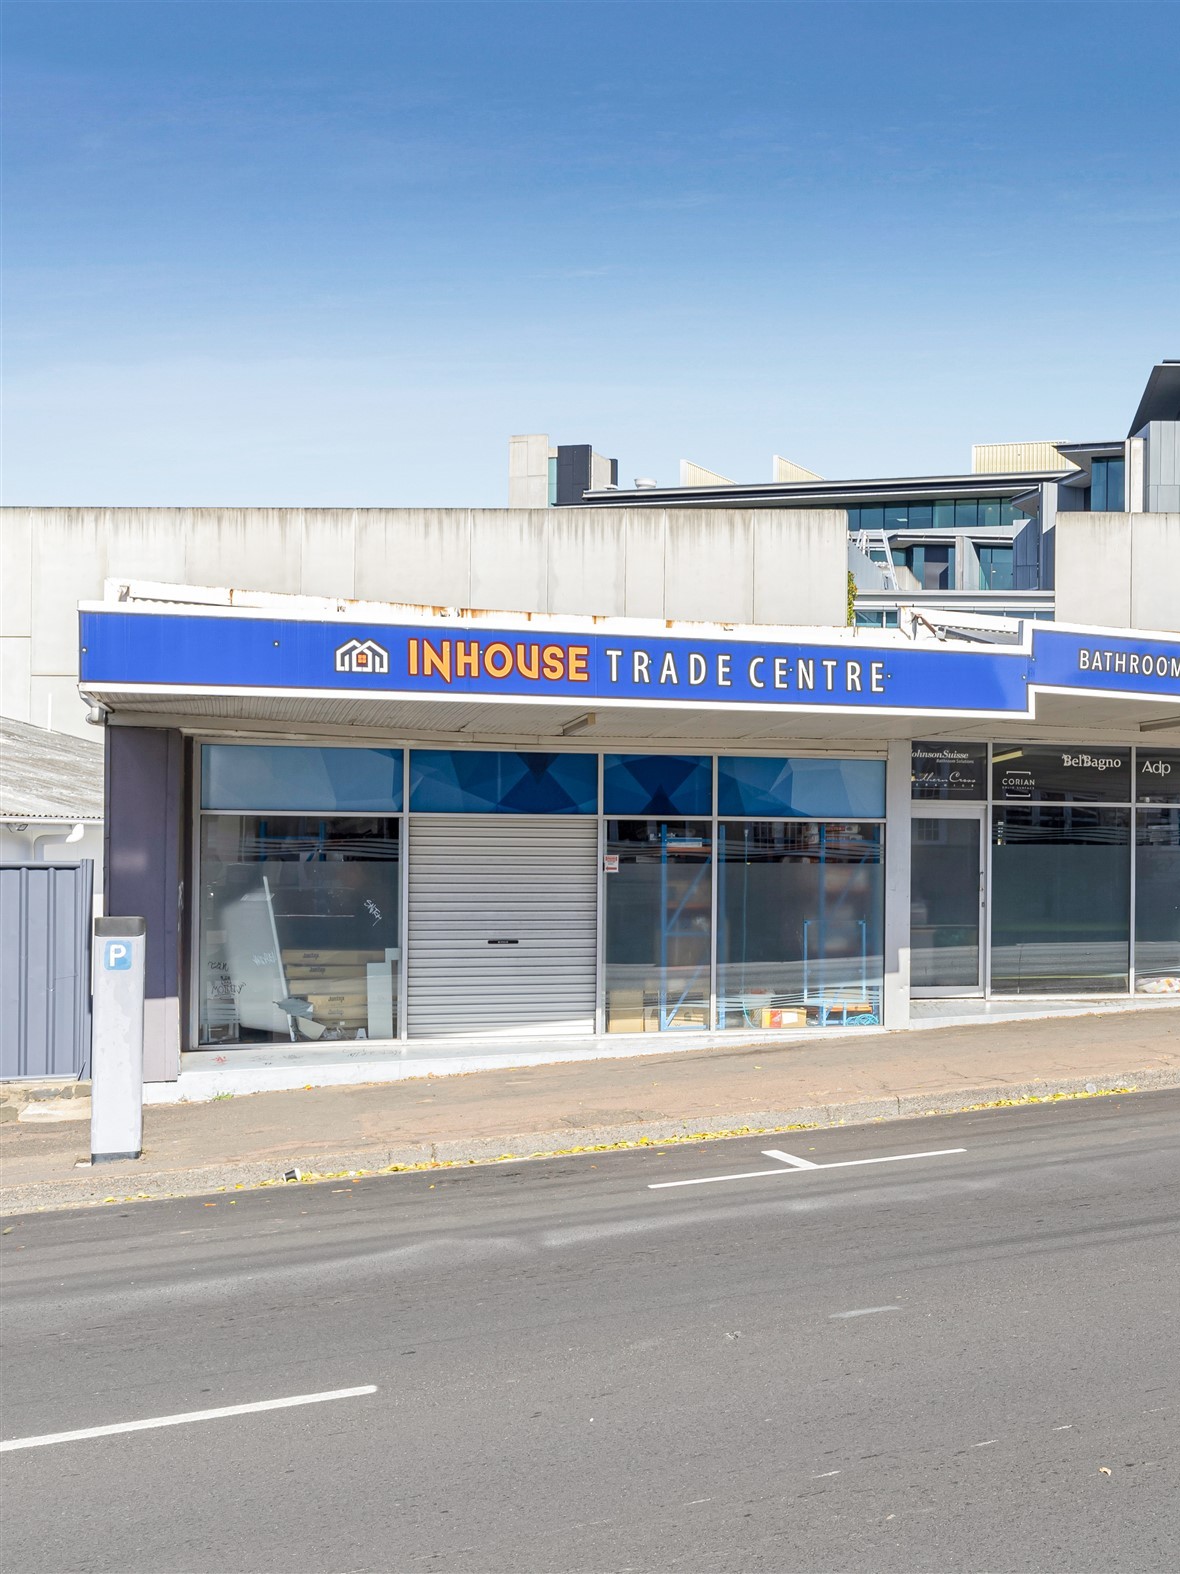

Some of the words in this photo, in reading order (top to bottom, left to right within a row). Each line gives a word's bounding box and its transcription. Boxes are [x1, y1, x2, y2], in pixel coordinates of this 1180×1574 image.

[407, 637, 590, 684] INHOUSE
[605, 649, 732, 687] TRADE
[748, 656, 884, 693] CENTRE
[1062, 754, 1122, 771] BelBagno
[1142, 761, 1171, 777] Adp
[1002, 778, 1036, 786] CORIAN
[109, 944, 127, 967] P
